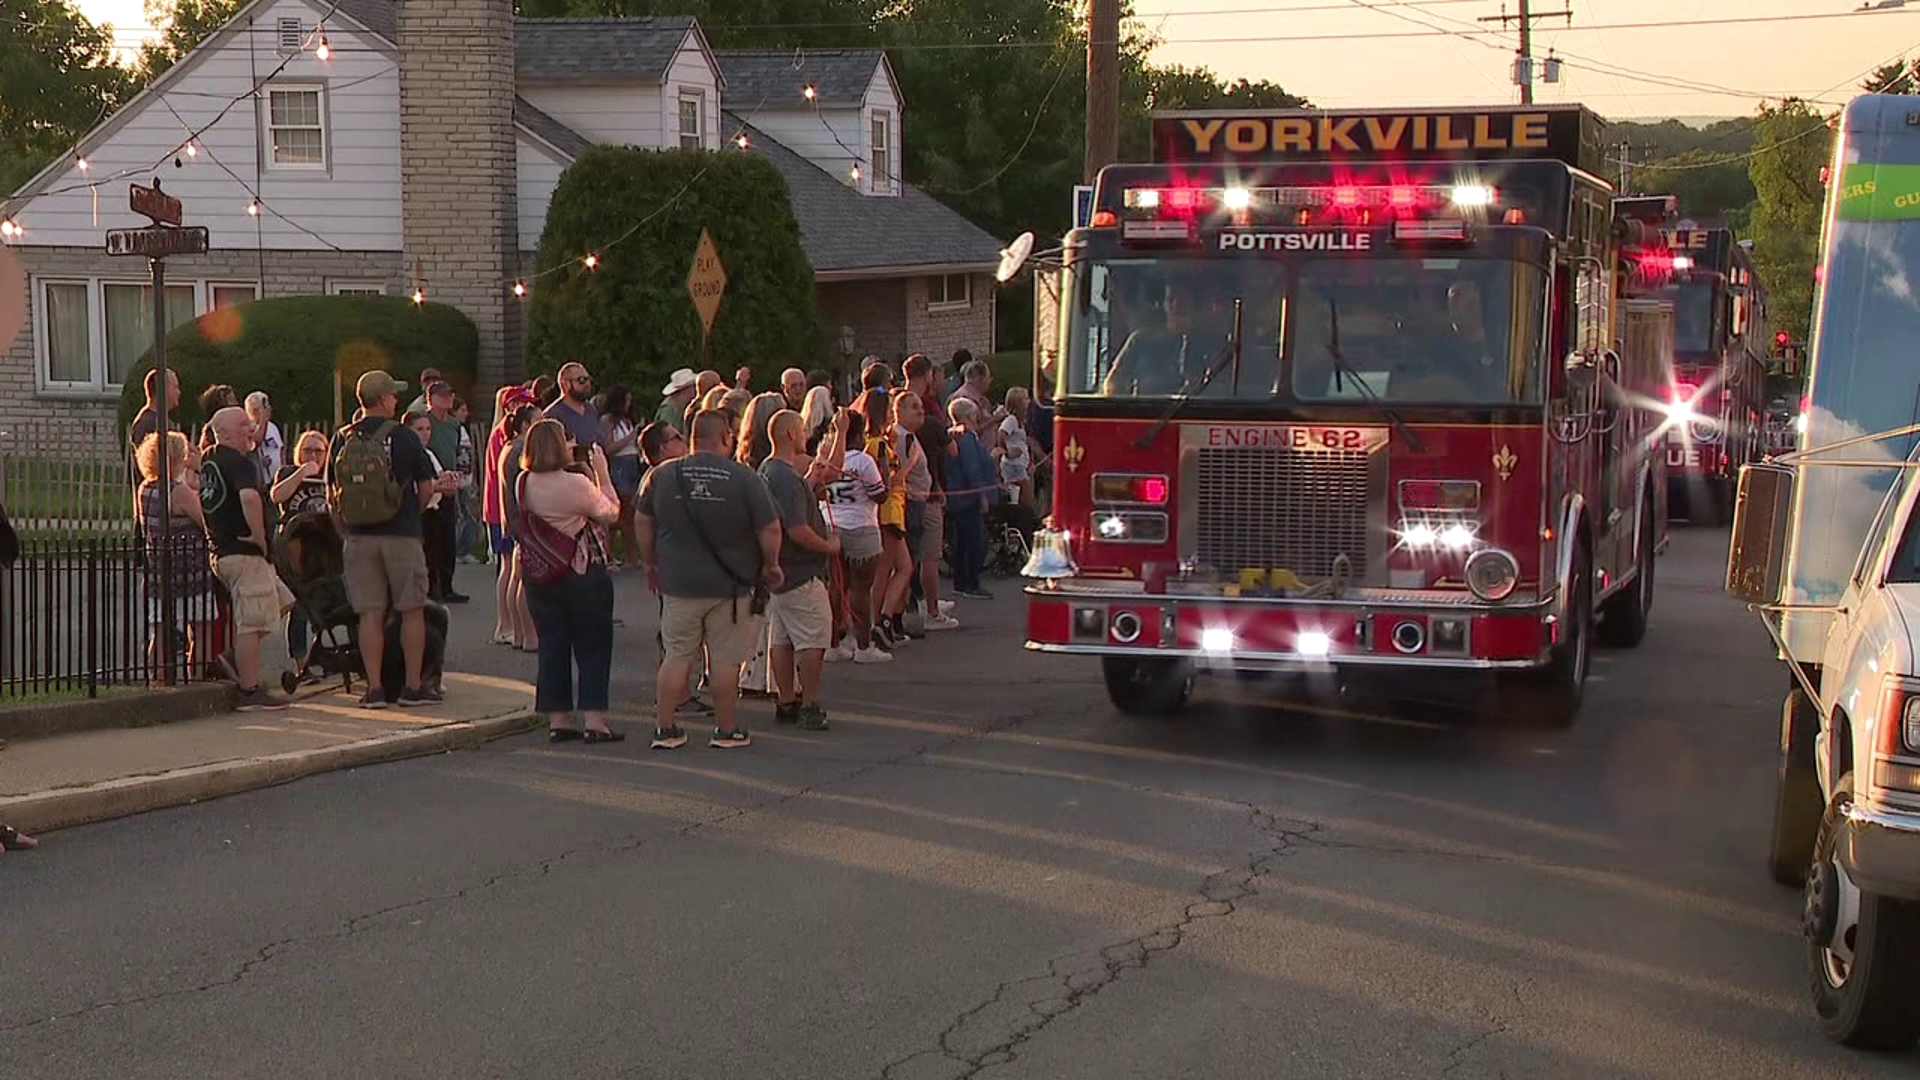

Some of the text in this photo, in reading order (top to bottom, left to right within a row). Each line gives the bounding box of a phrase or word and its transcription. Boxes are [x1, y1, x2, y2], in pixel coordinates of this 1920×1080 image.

[1185, 114, 1548, 152] YORKVILLE
[1219, 233, 1371, 251] POTTSVILLE
[697, 256, 716, 273] PLAY
[692, 279, 721, 298] GROUND
[1208, 428, 1361, 448] ENGINE 62
